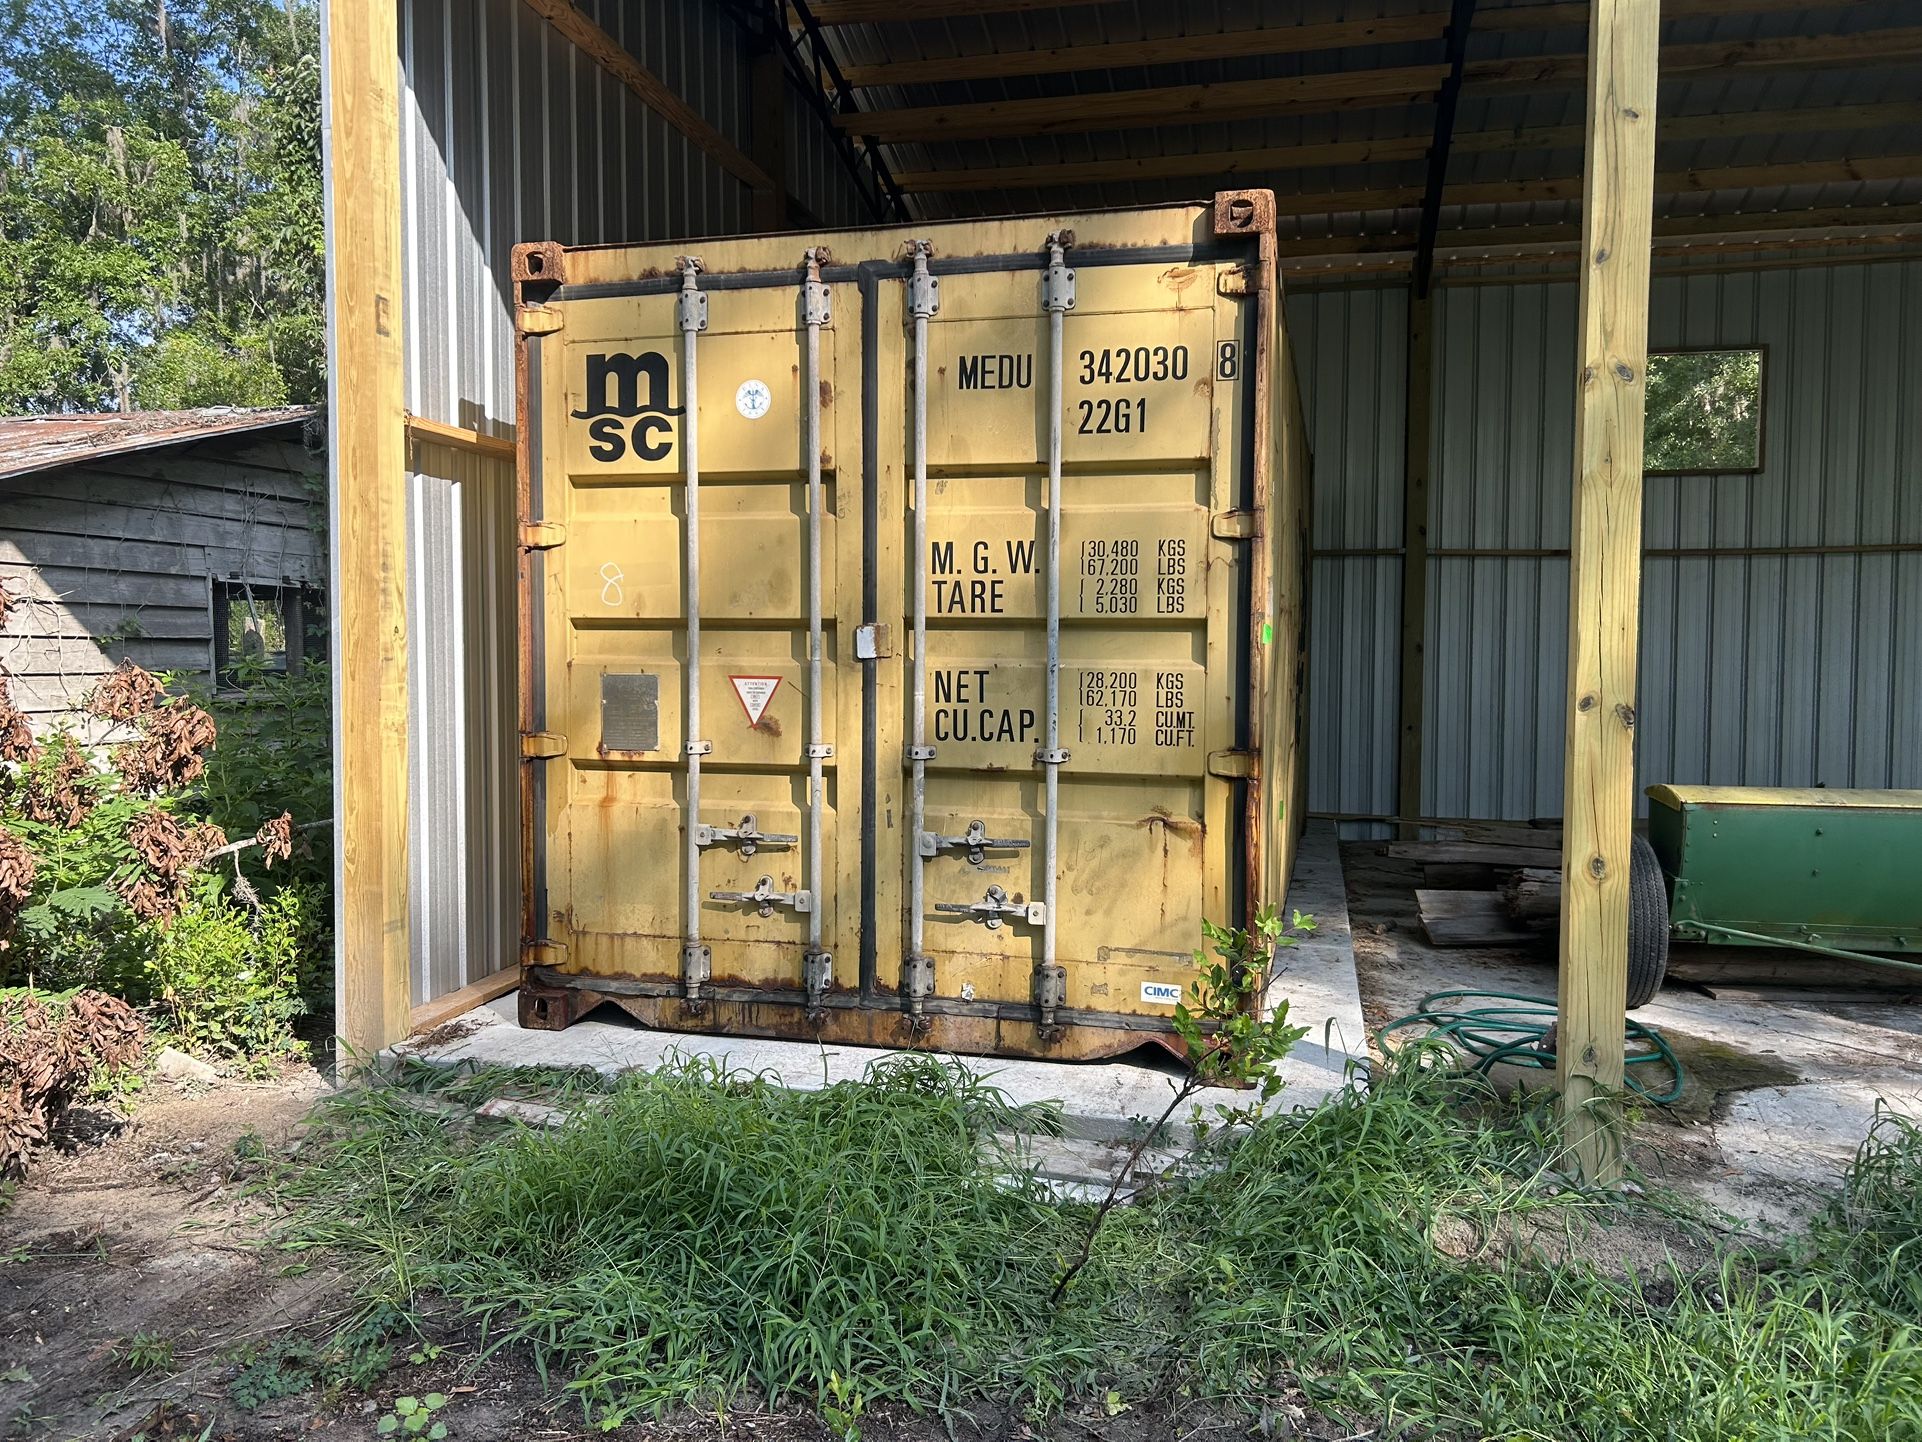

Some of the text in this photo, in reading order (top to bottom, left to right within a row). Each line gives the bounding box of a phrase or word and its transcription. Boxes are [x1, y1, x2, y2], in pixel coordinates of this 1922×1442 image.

[958, 342, 1237, 390] MEDU 342030 8
[1077, 397, 1147, 434] 22G1
[1088, 539, 1186, 558] 30,480 KGS
[1087, 558, 1186, 576] 67,200 LBS
[1096, 577, 1185, 596] 2,280 KGS
[931, 580, 1004, 614] TARE
[1095, 595, 1185, 614] 5,030 LBS
[934, 670, 990, 704] NET
[1086, 672, 1184, 690] 28,200 KGS
[1086, 689, 1184, 708] 62,170 LBS
[934, 709, 1040, 744] CU.CAP.
[1104, 709, 1137, 727] 33.2
[1096, 726, 1137, 745] 1,170
[1143, 985, 1179, 998] CIMC
